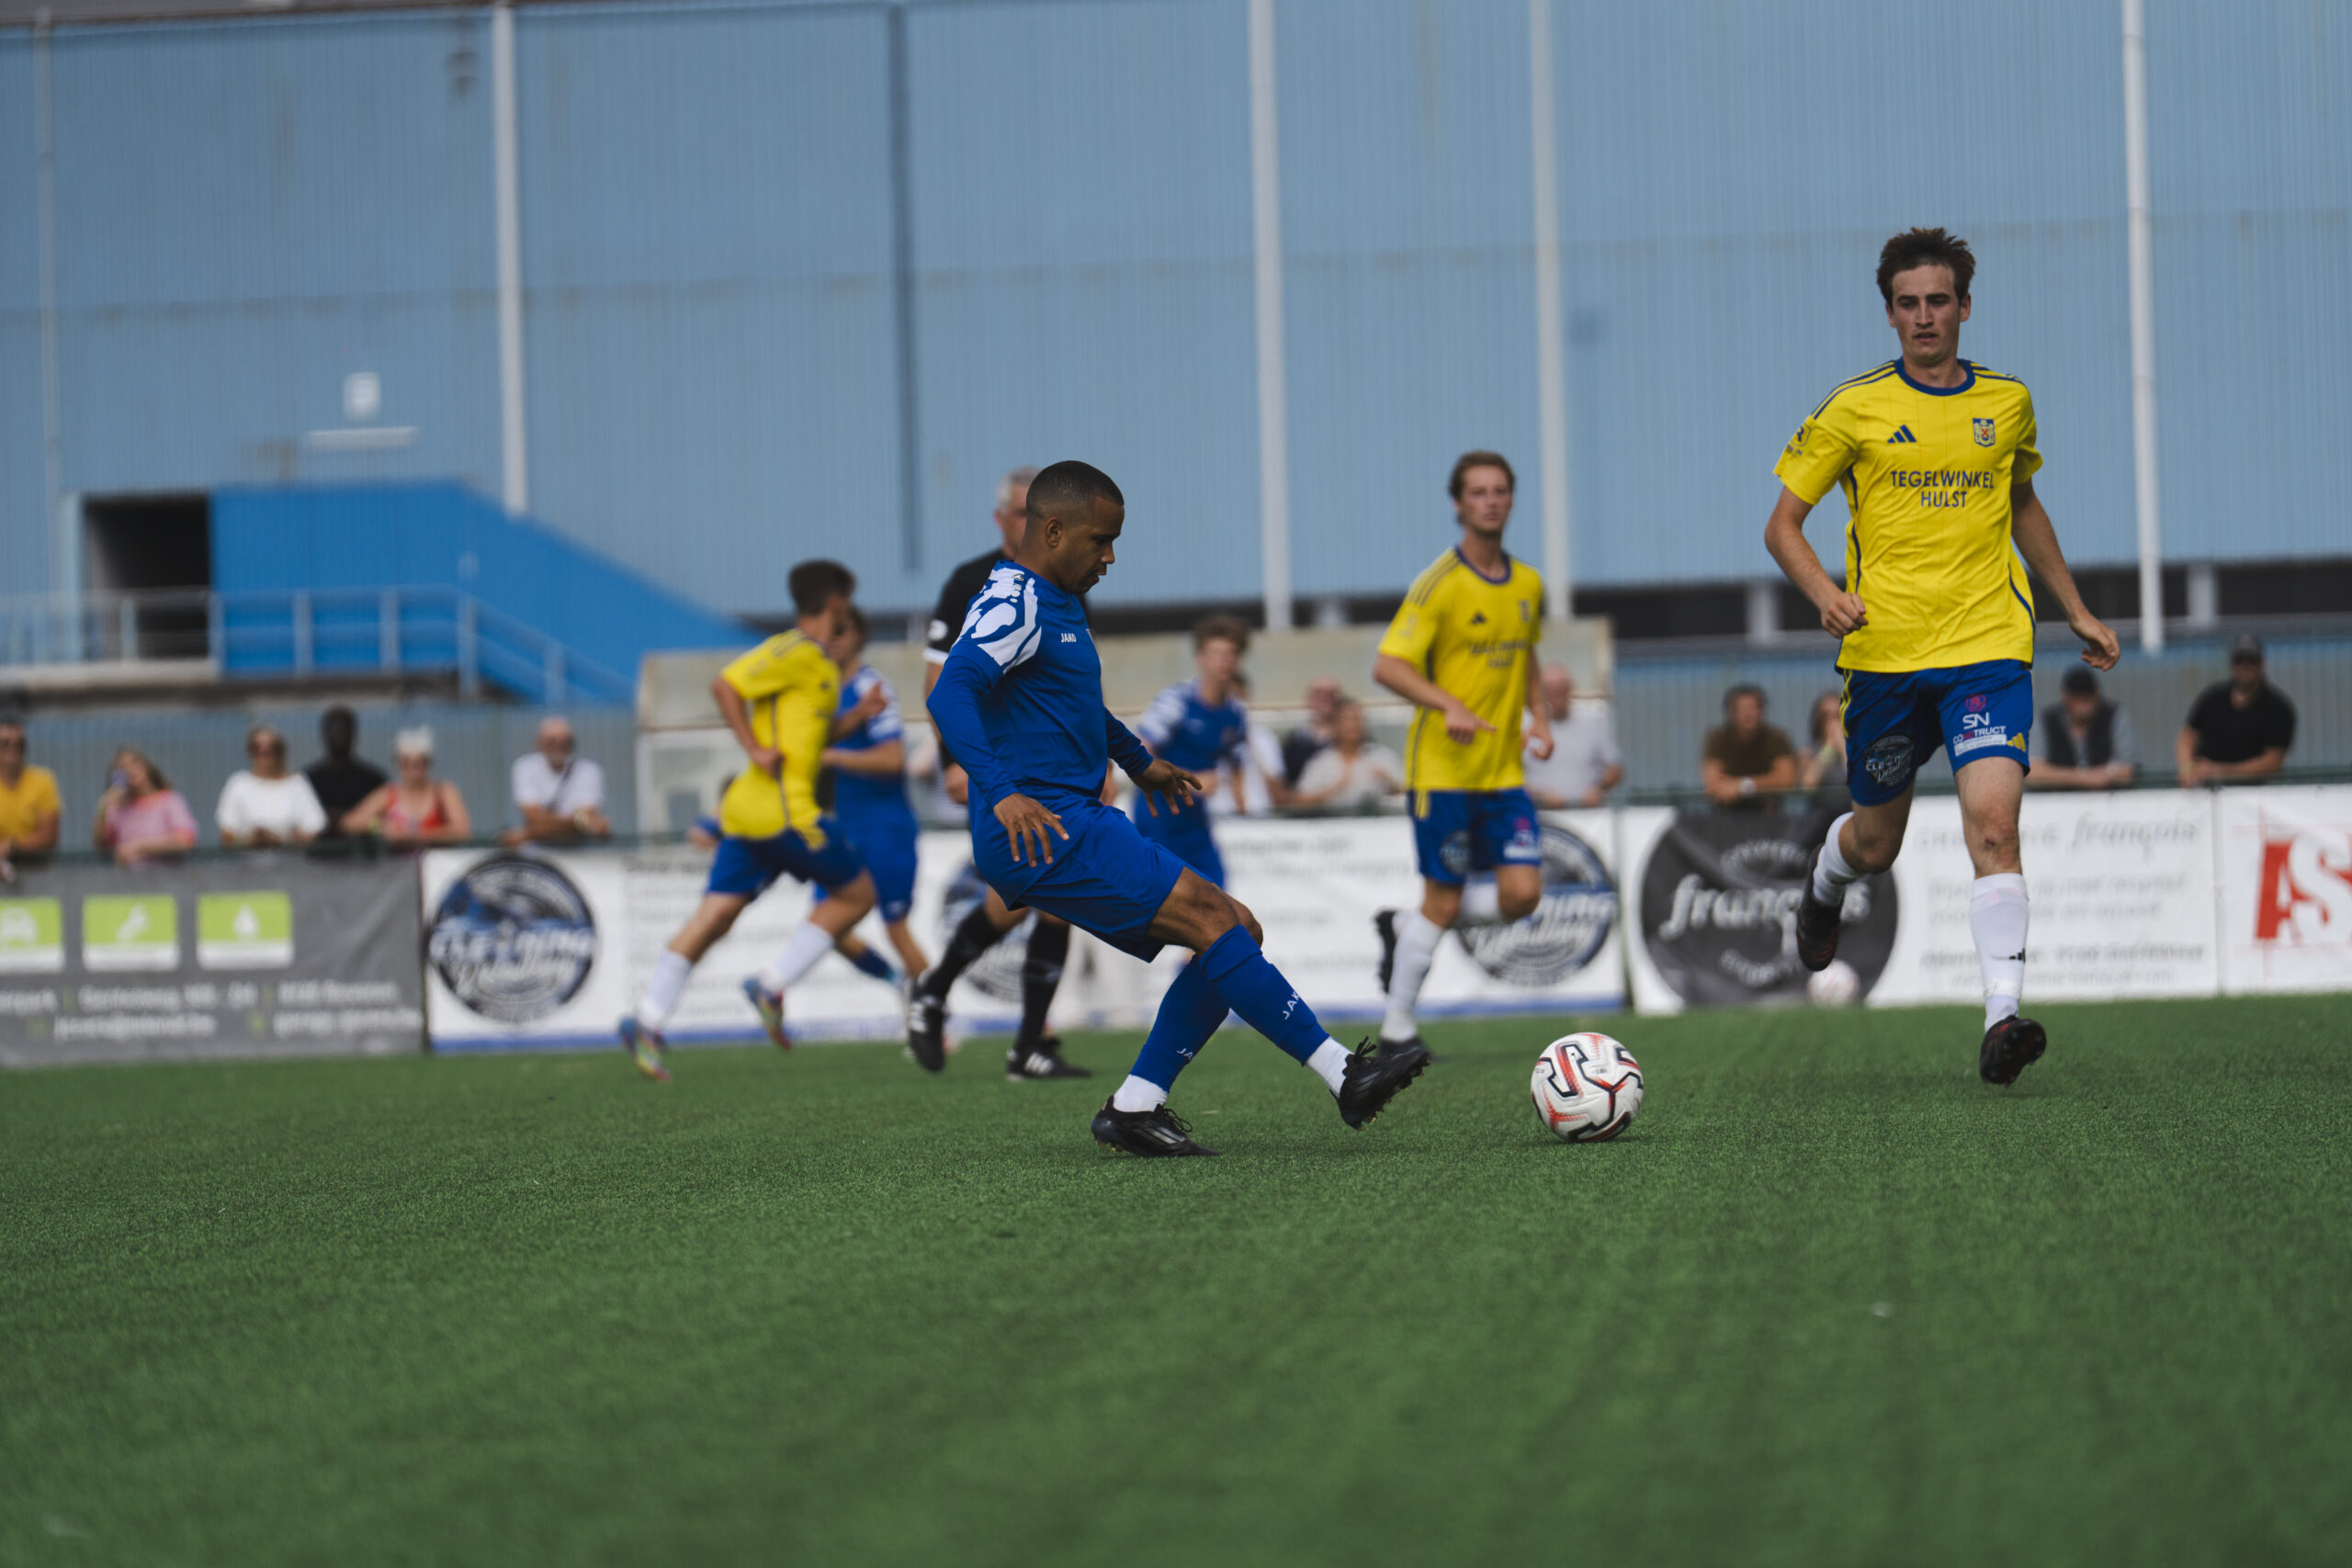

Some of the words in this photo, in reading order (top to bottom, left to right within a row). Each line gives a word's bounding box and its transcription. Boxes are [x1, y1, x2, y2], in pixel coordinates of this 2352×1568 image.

[1890, 469, 1995, 490] TEGELWINKEL
[1920, 491, 1968, 508] HULST
[1060, 632, 1077, 643] JAKO
[1962, 711, 1990, 730] SN
[2254, 830, 2352, 946] AS
[1283, 991, 1300, 1020] JAK
[1176, 1047, 1194, 1061] JA
